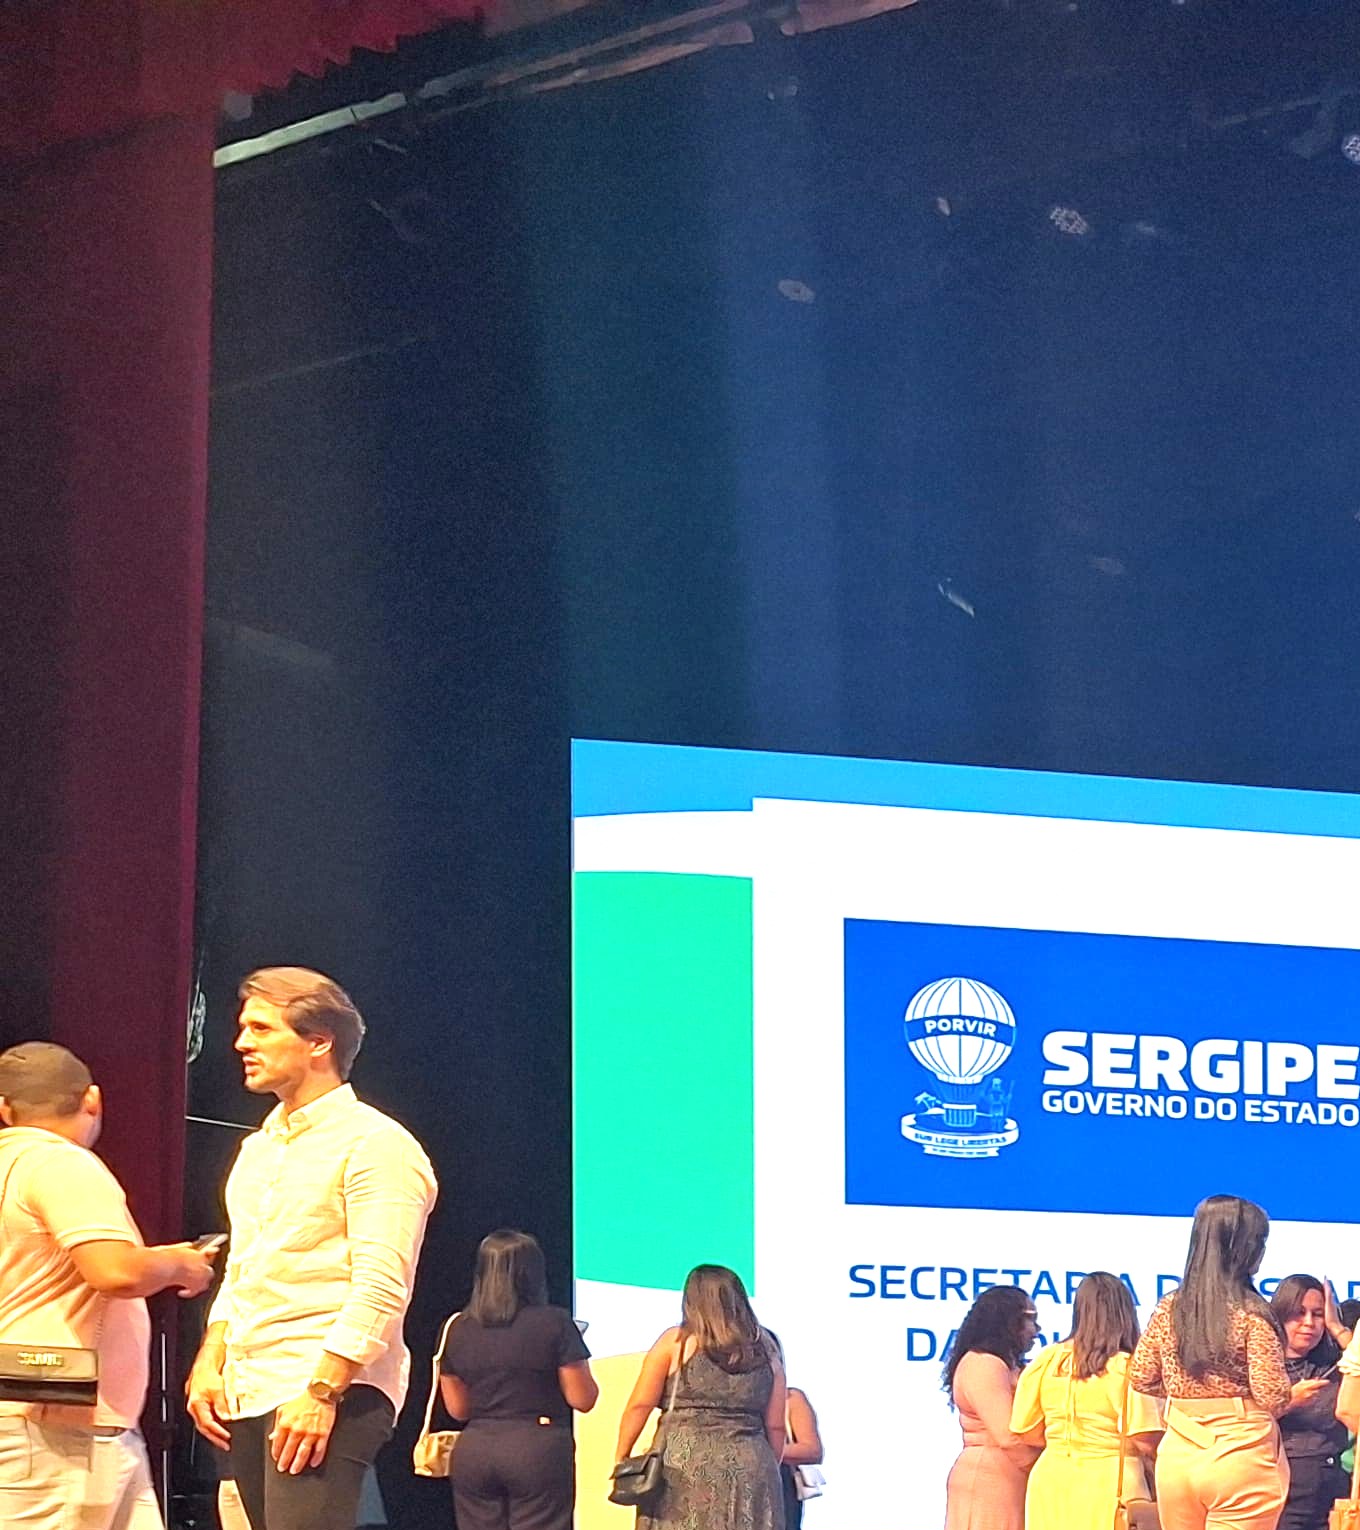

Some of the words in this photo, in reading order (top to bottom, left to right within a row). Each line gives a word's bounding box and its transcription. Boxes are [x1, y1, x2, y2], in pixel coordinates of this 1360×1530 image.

[924, 1017, 998, 1038] PORVIR
[1041, 1029, 1360, 1101] SERGIPE
[1041, 1089, 1188, 1120] GOVERNO
[1194, 1097, 1238, 1122] DO
[1243, 1099, 1360, 1128] ESTADO
